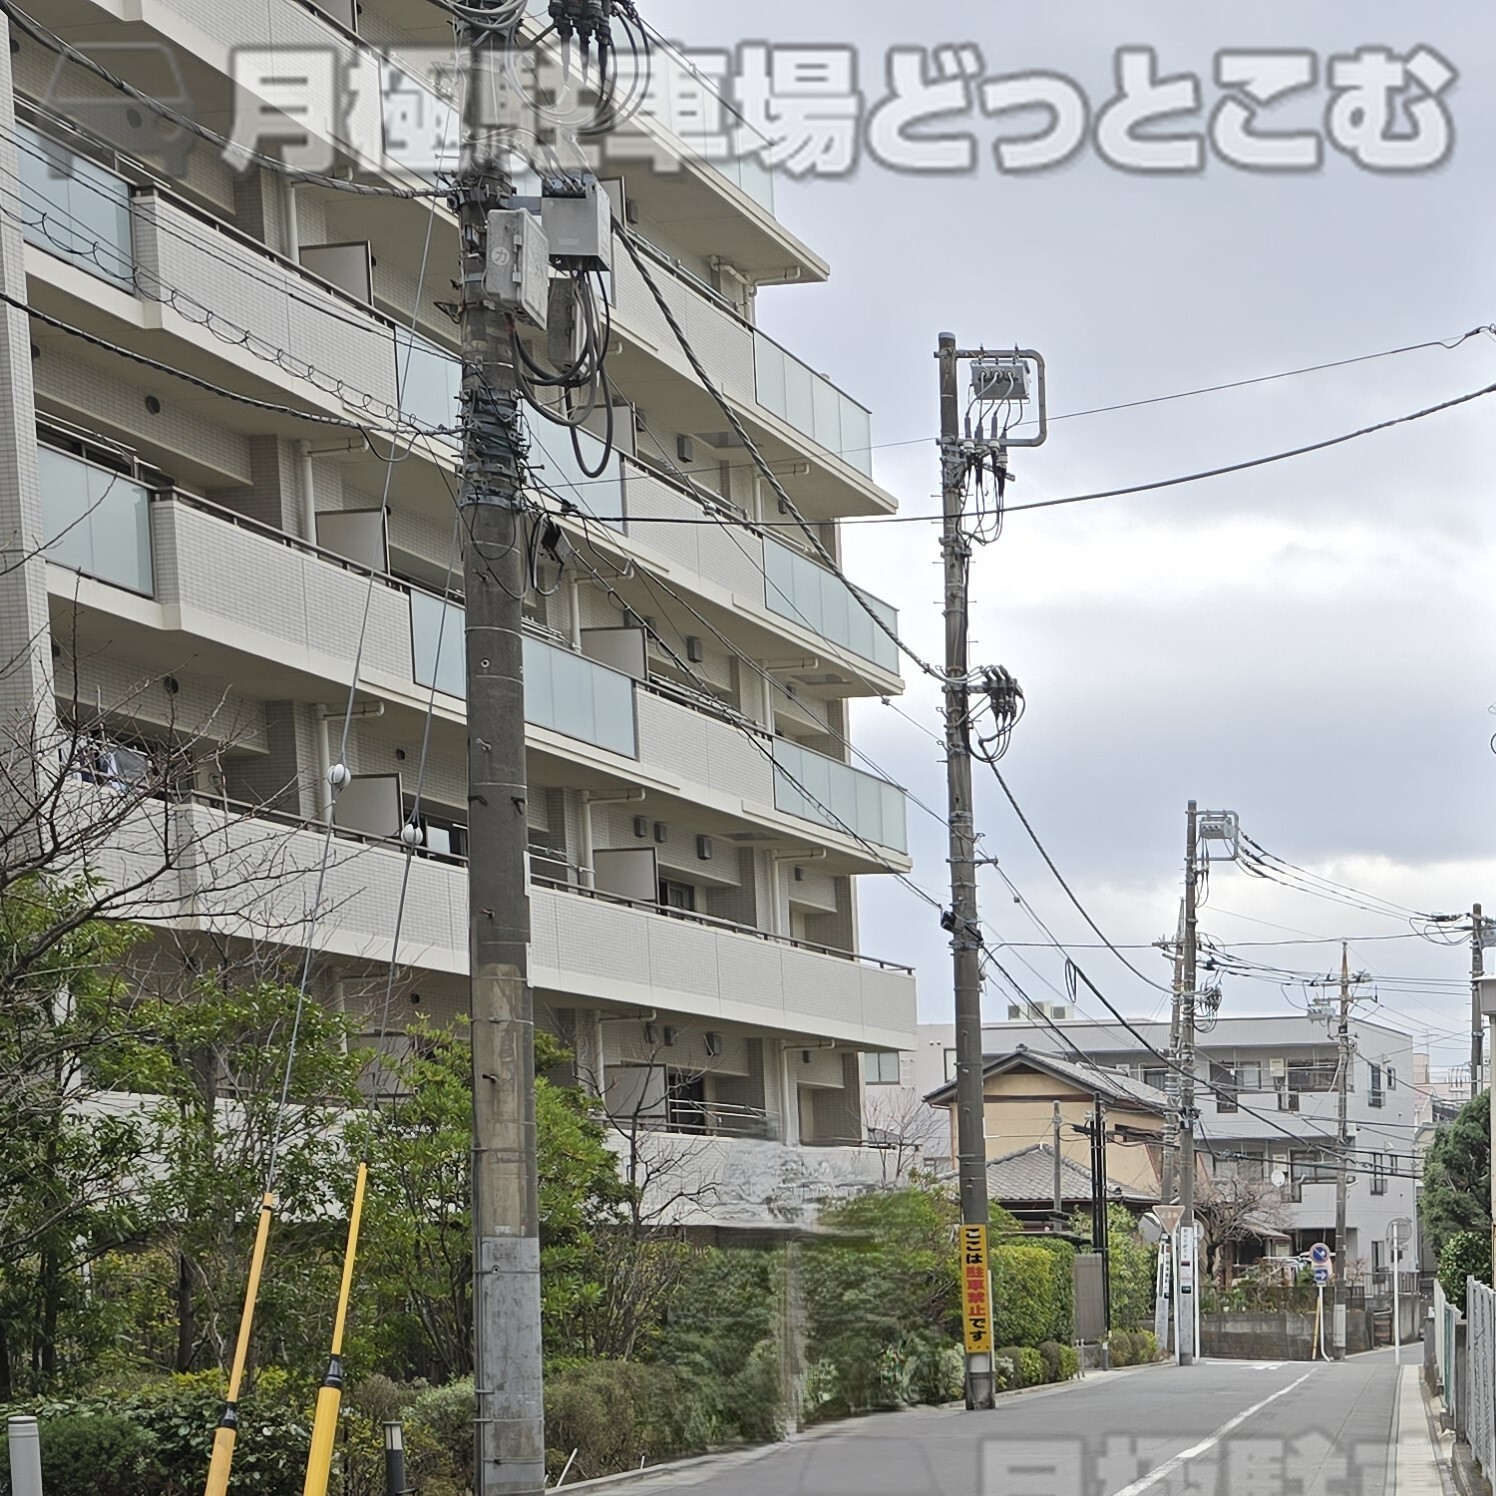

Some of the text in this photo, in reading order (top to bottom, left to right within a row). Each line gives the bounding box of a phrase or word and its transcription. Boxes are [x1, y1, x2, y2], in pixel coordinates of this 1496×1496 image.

[965, 1227, 987, 1342] ここは駐車禁止です
